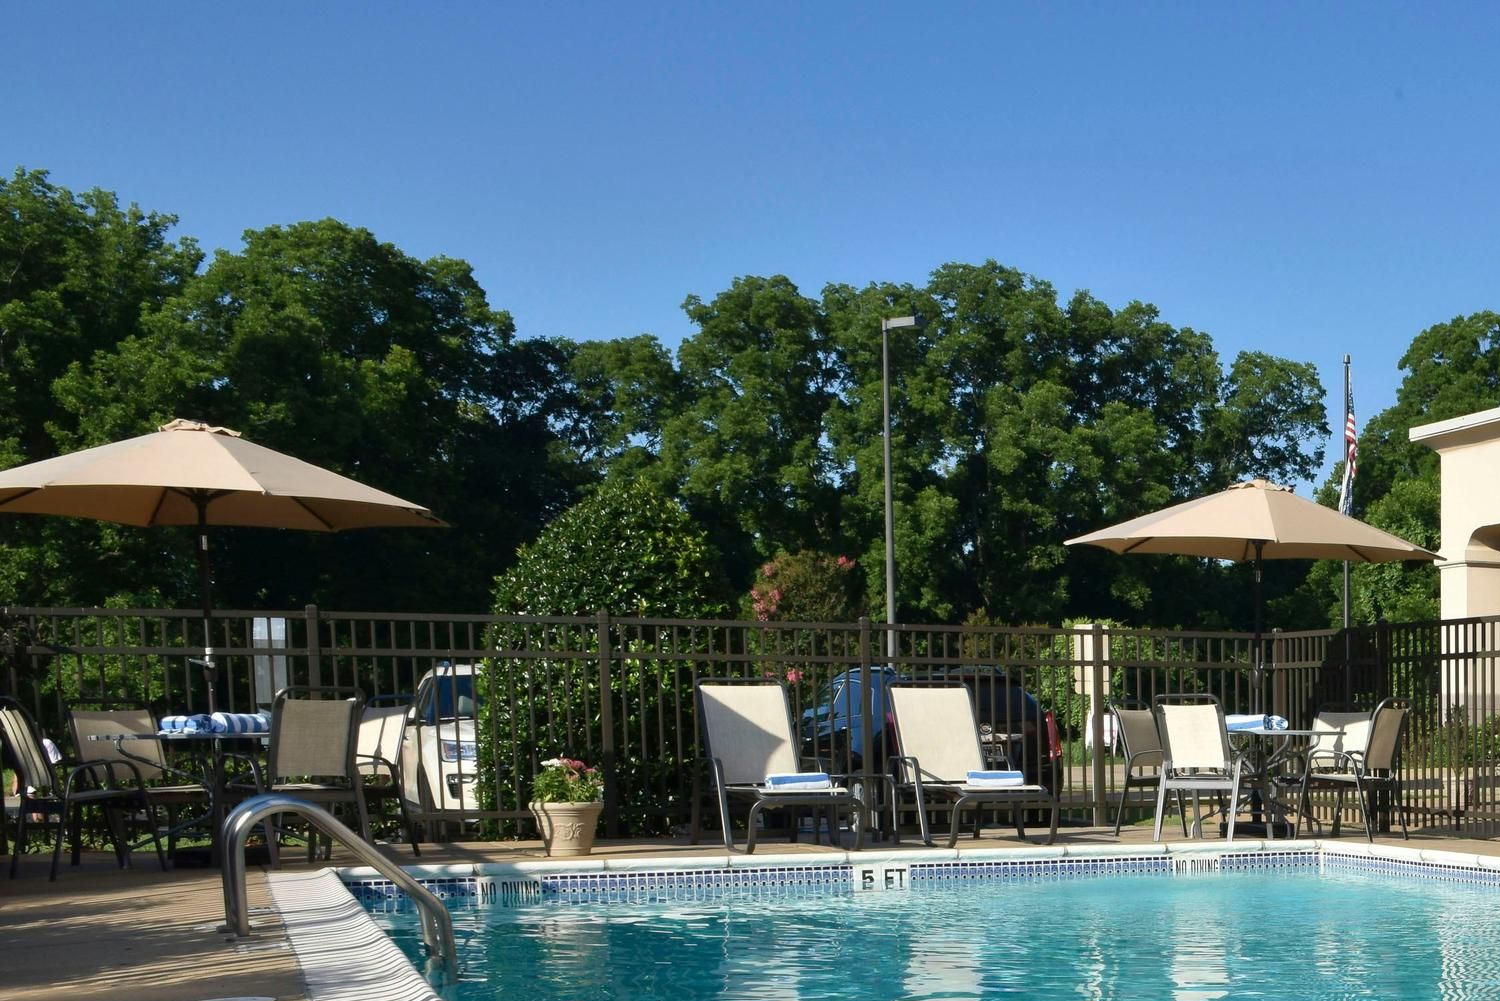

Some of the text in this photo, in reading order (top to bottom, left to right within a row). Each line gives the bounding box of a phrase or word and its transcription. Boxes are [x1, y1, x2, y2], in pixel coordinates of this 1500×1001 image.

[1175, 858, 1219, 874] NO DIVING
[862, 868, 907, 890] 5 FT
[481, 880, 540, 905] NO DIVING
